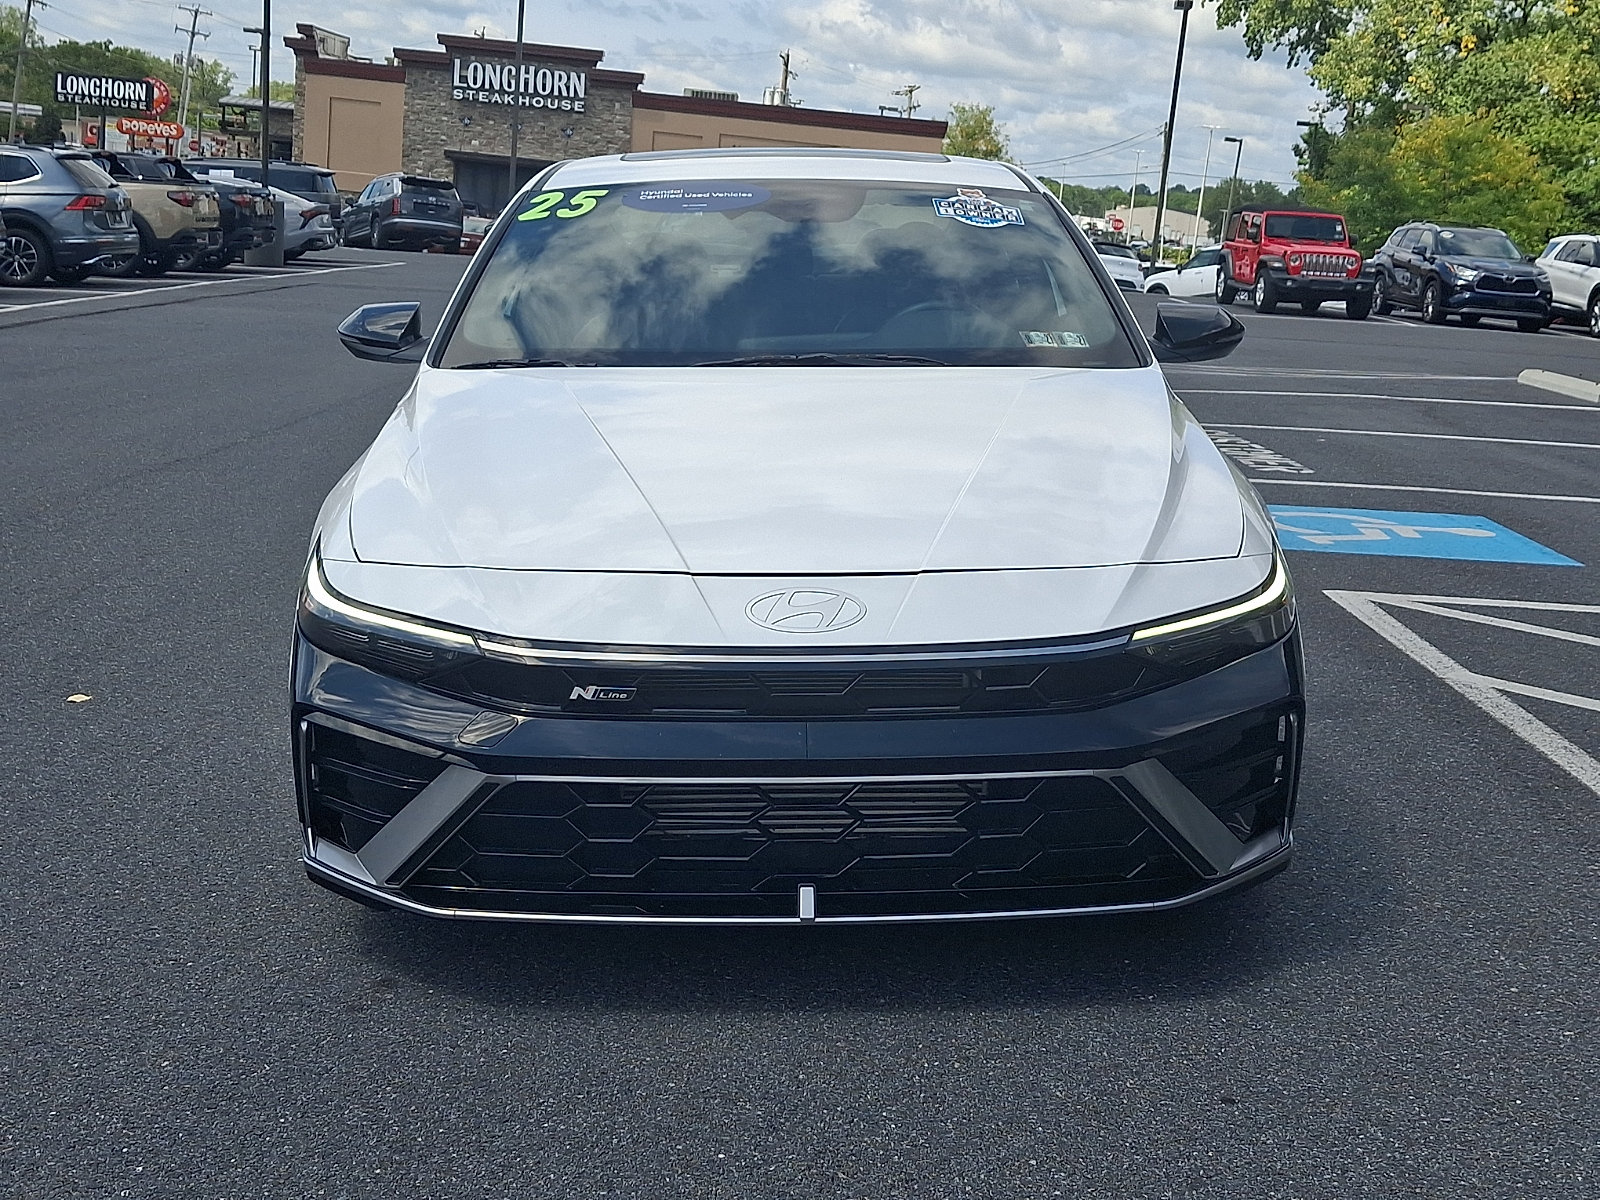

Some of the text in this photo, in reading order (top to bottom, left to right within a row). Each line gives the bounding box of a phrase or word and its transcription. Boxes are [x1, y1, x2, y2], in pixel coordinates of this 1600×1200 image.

[57, 73, 147, 101] LONGHORN
[453, 58, 587, 98] LONGHORN
[57, 93, 147, 110] STEAKHOUSE
[453, 89, 586, 113] STEAKHOUSE
[640, 188, 684, 196] Hyundai
[517, 189, 610, 221] 25
[939, 201, 1017, 215] CARFAX
[599, 691, 628, 699] Line
